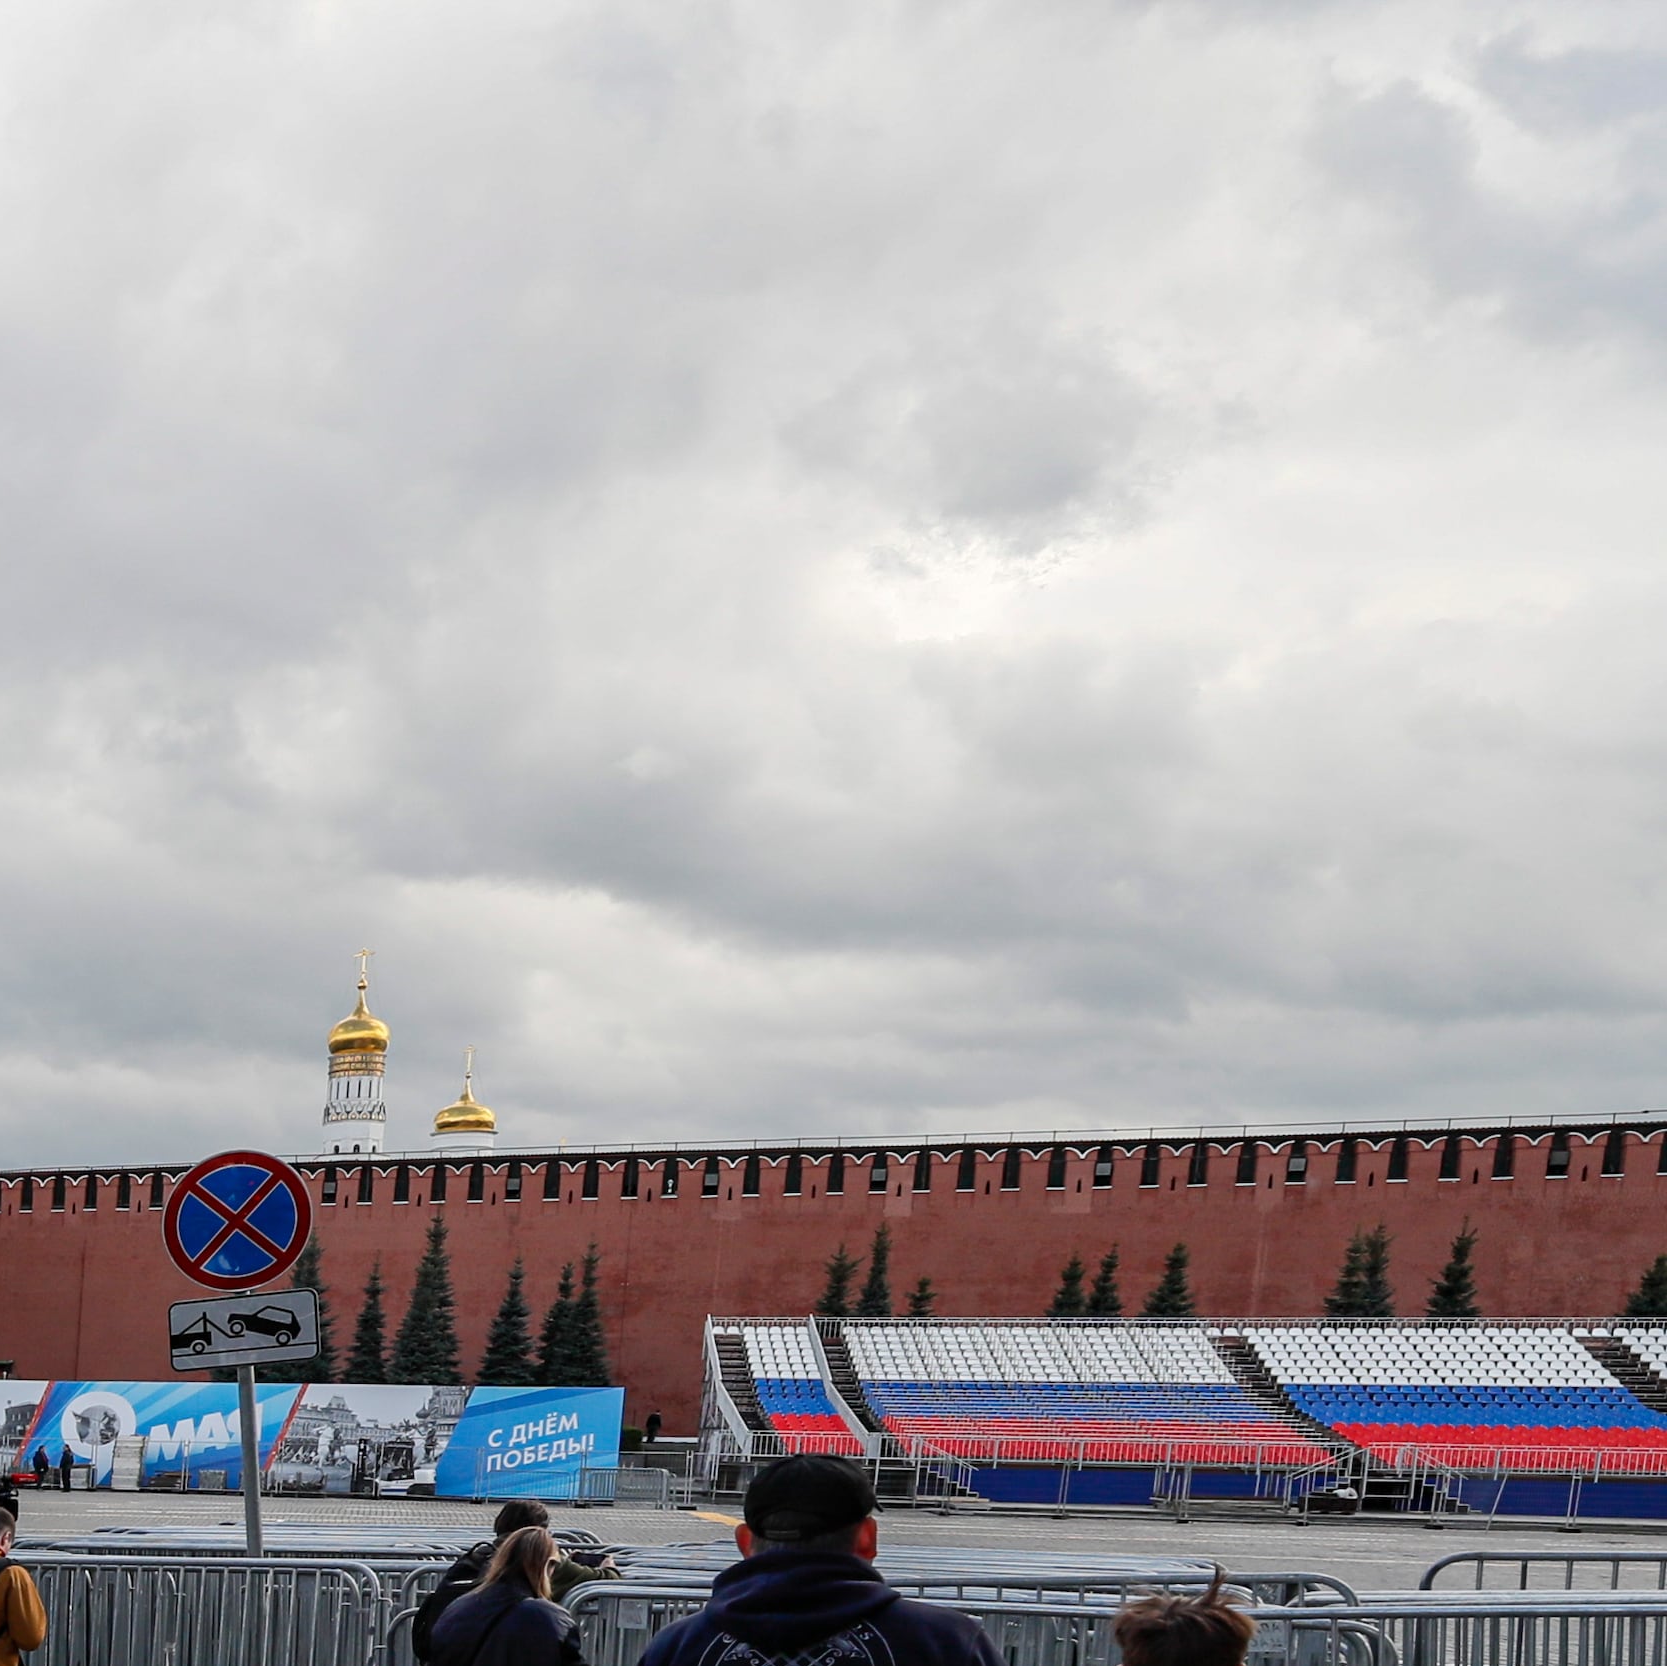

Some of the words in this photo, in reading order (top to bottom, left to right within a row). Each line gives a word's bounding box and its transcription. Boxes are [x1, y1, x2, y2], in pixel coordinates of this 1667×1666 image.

[488, 1429, 503, 1447] С
[508, 1412, 579, 1447] ДНЁМ
[487, 1433, 595, 1473] ПОБЕДЫ!
